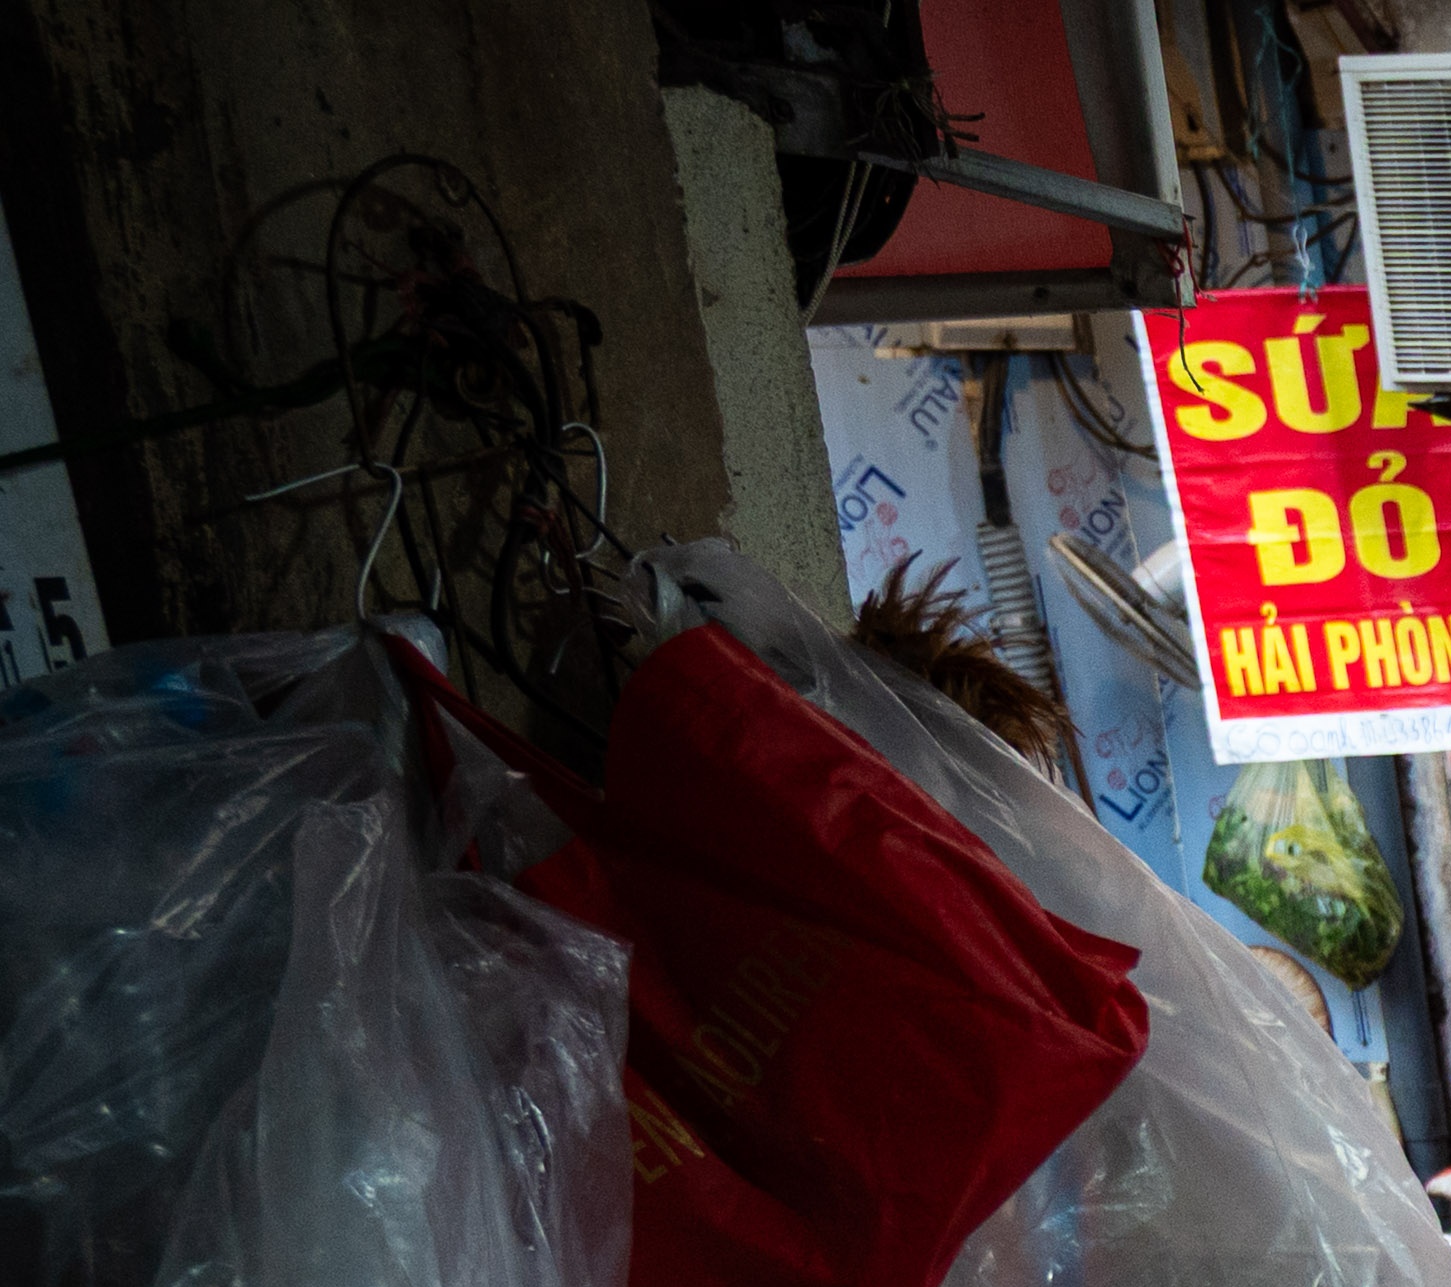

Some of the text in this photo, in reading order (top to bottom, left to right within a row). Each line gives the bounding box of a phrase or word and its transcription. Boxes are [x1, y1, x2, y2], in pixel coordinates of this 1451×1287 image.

[1080, 488, 1127, 548] ION
[1246, 450, 1442, 587] ĐỎ
[1220, 602, 1317, 697] HẢI
[627, 1088, 706, 1185] EN
